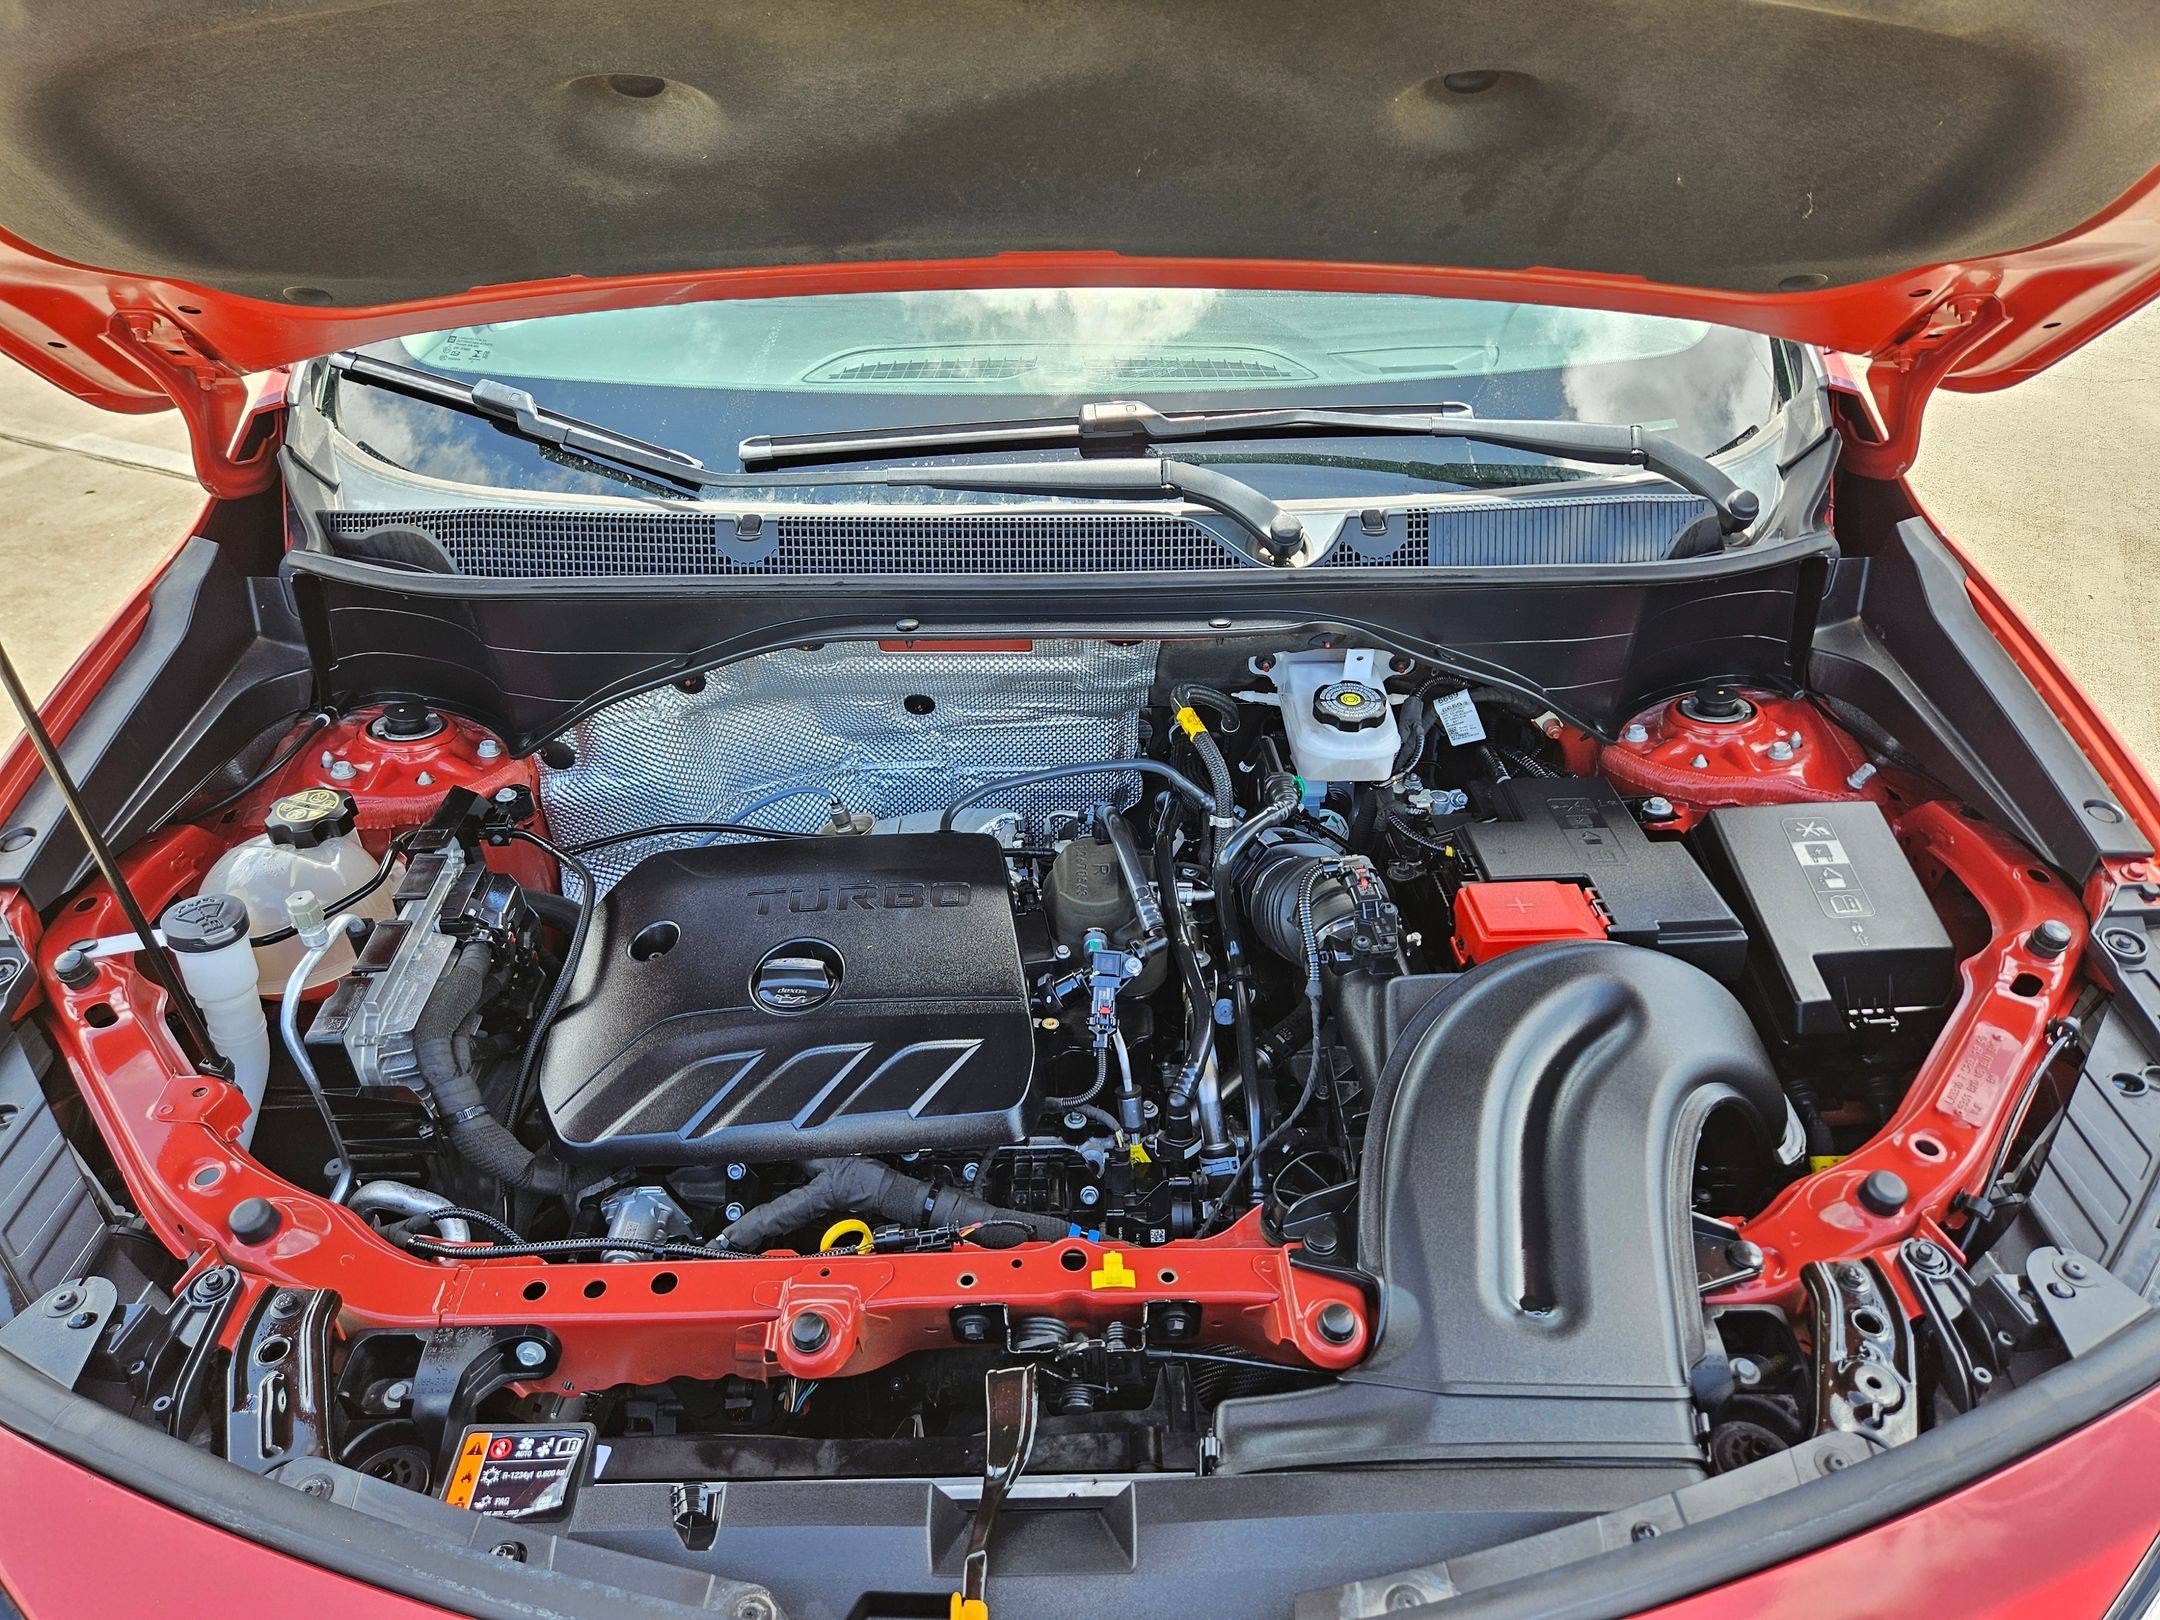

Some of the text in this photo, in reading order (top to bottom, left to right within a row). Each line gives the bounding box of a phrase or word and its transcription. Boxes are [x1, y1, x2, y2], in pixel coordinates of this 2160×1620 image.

[748, 882, 971, 915] TURBO
[777, 987, 807, 995] dexos
[502, 1470, 534, 1480] R-1234yf
[494, 1496, 511, 1507] PAG
